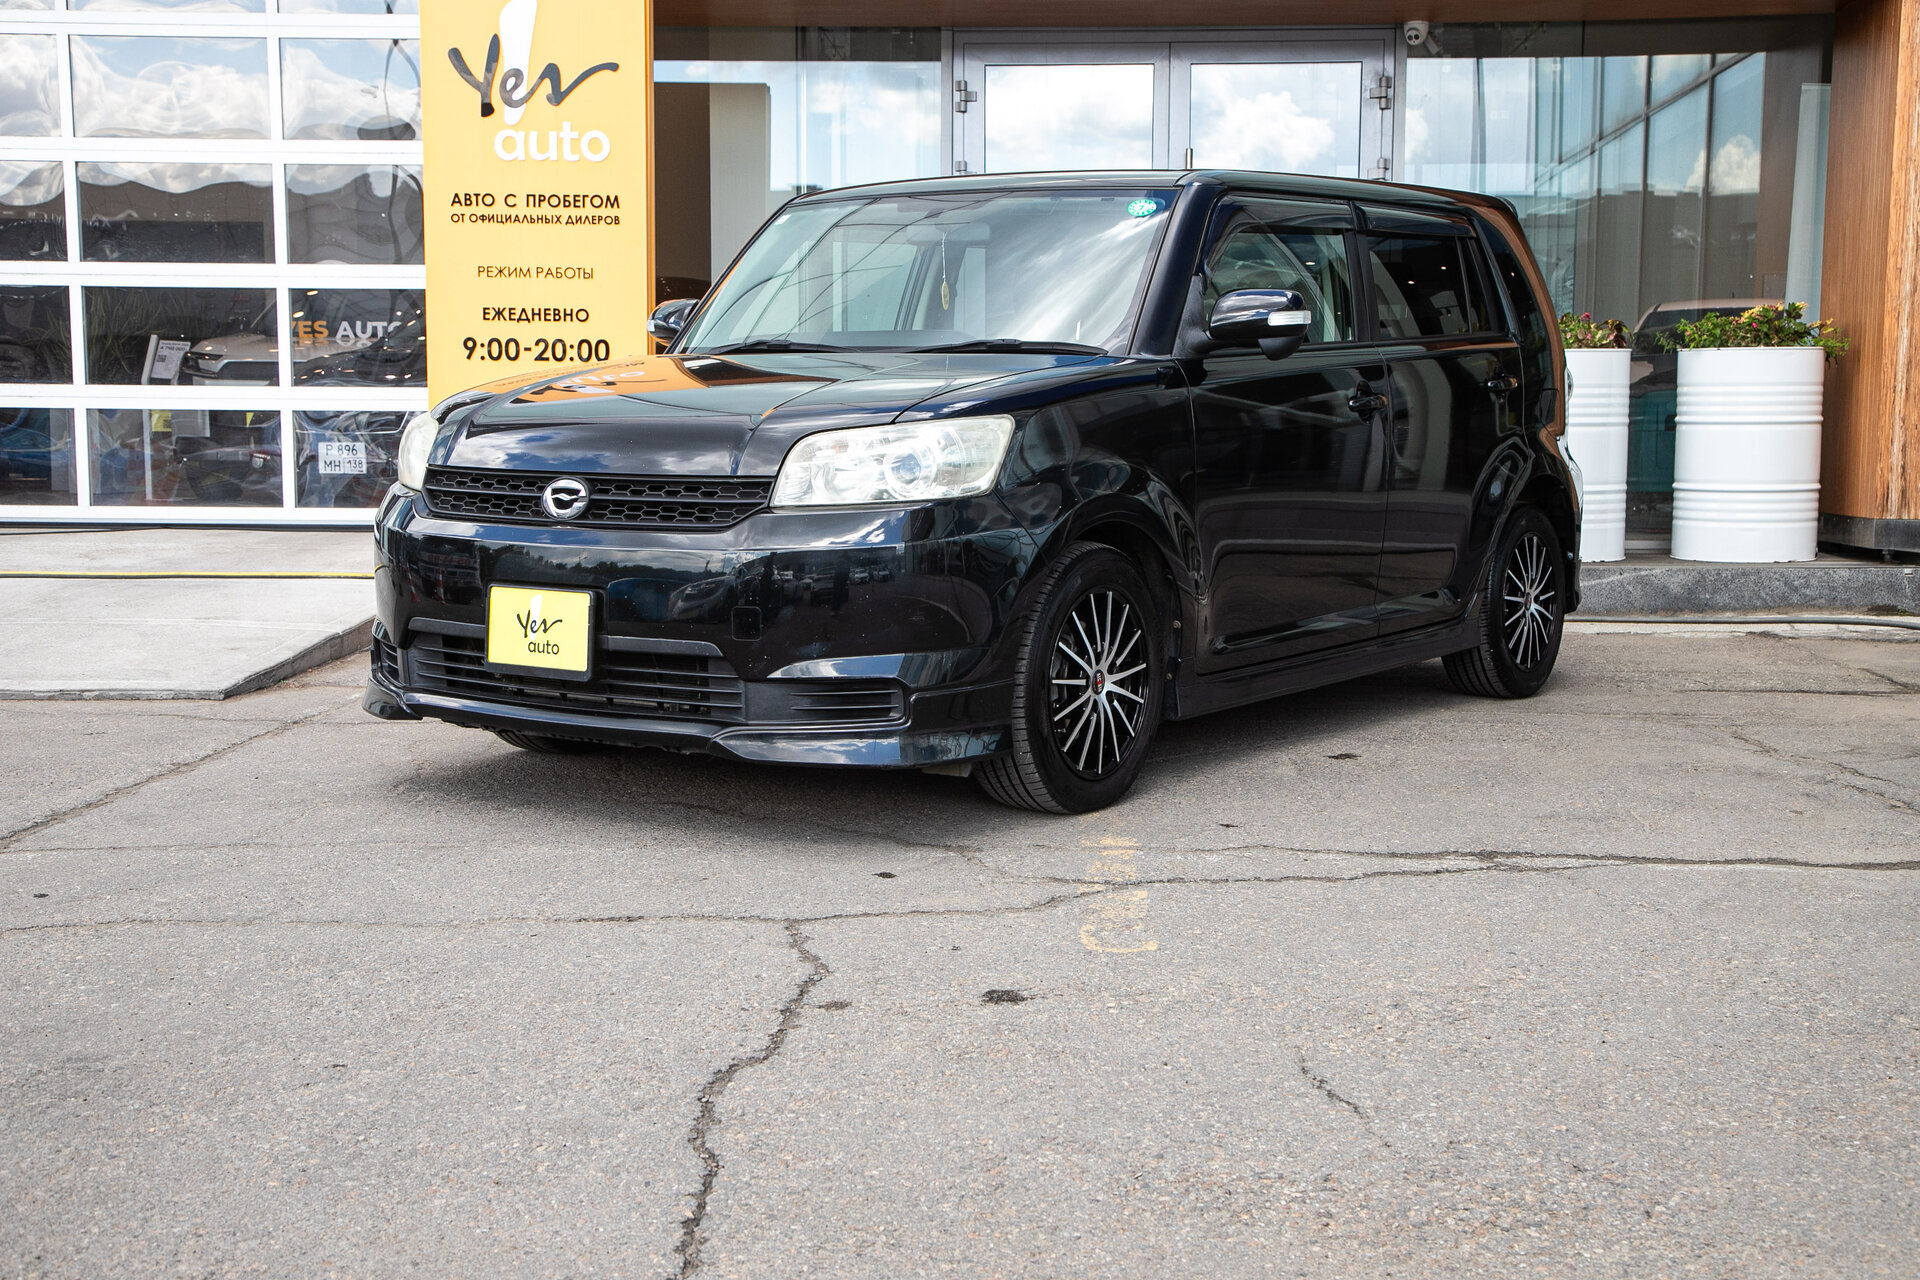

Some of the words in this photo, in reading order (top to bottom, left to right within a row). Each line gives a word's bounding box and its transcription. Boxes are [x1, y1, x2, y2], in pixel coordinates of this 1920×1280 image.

[448, 33, 620, 118] Yes
[494, 121, 610, 162] auto
[450, 192, 496, 208] АВТО
[504, 193, 517, 208] С
[525, 194, 621, 209] ПРОБЕГОМ
[450, 213, 465, 224] ОТ
[468, 213, 562, 225] ОФИЦИАЛЬНЫХ
[564, 215, 621, 226] ДИЛЕРОВ
[477, 265, 532, 279] РЕЖИМ
[535, 267, 594, 280] РАБОТЫ
[482, 307, 590, 323] ЕЖЕДНЕВНО
[462, 336, 611, 363] 9:00-20:00
[337, 444, 358, 456] 896
[346, 459, 364, 469] 138
[527, 640, 560, 655] auto
